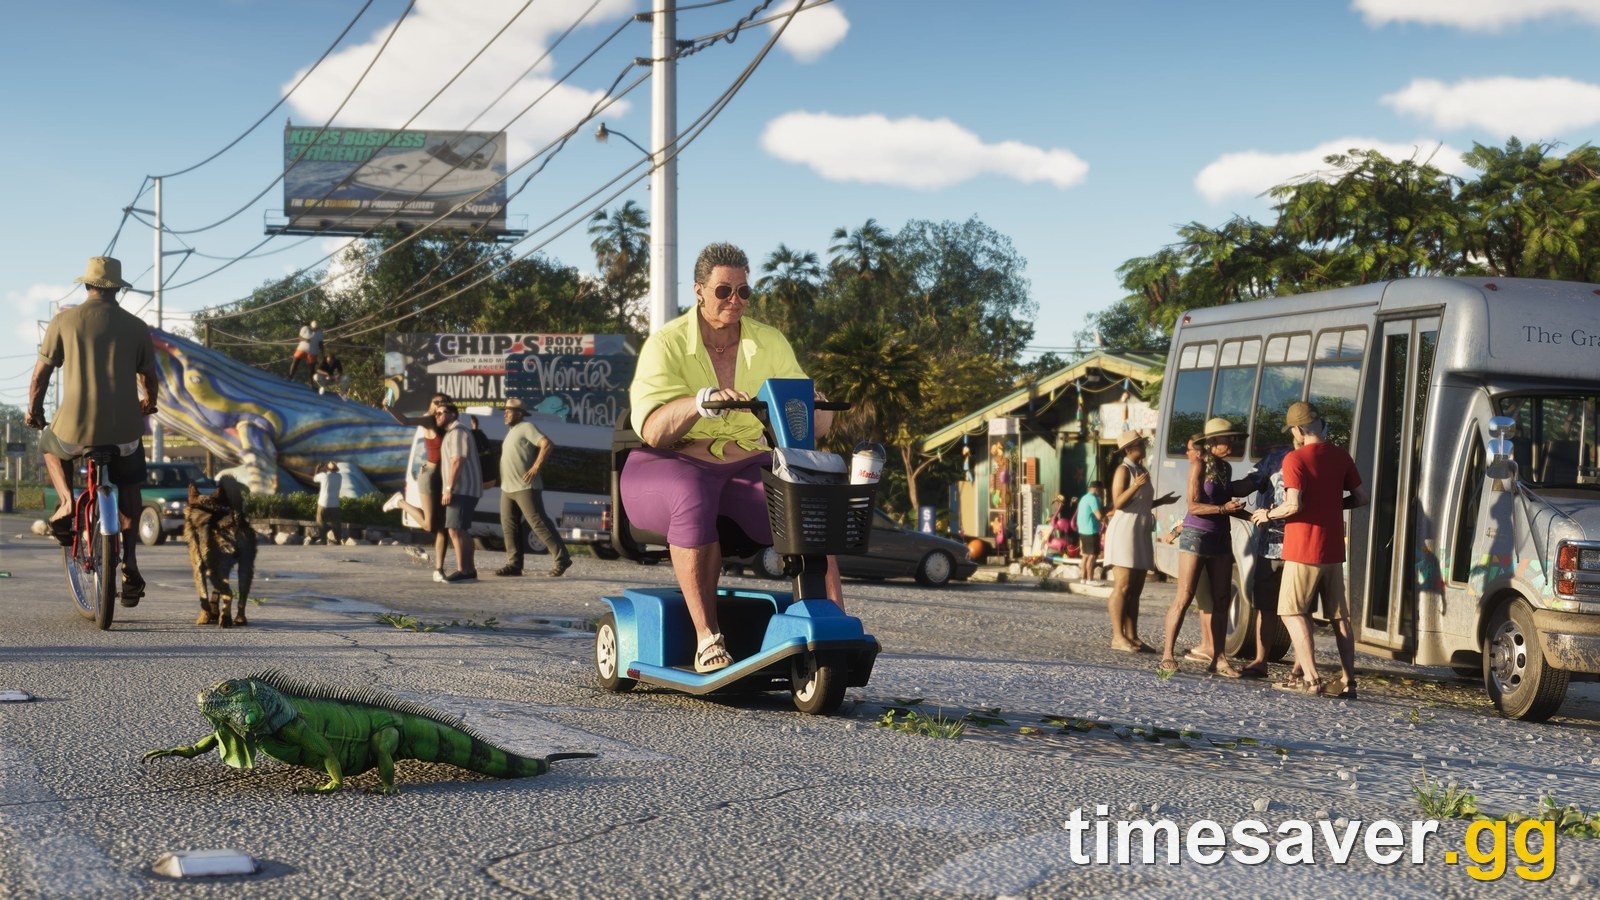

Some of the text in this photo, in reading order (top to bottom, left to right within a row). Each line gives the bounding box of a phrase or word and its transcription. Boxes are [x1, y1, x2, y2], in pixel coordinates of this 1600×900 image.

[343, 131, 426, 147] BUSINESS
[439, 335, 540, 355] CHIP'S
[545, 336, 583, 346] BODY
[1522, 325, 1600, 347] The Gr
[545, 346, 584, 355] SHOP
[436, 375, 484, 399] HAVING
[487, 375, 497, 399] A
[561, 393, 616, 426] Whal
